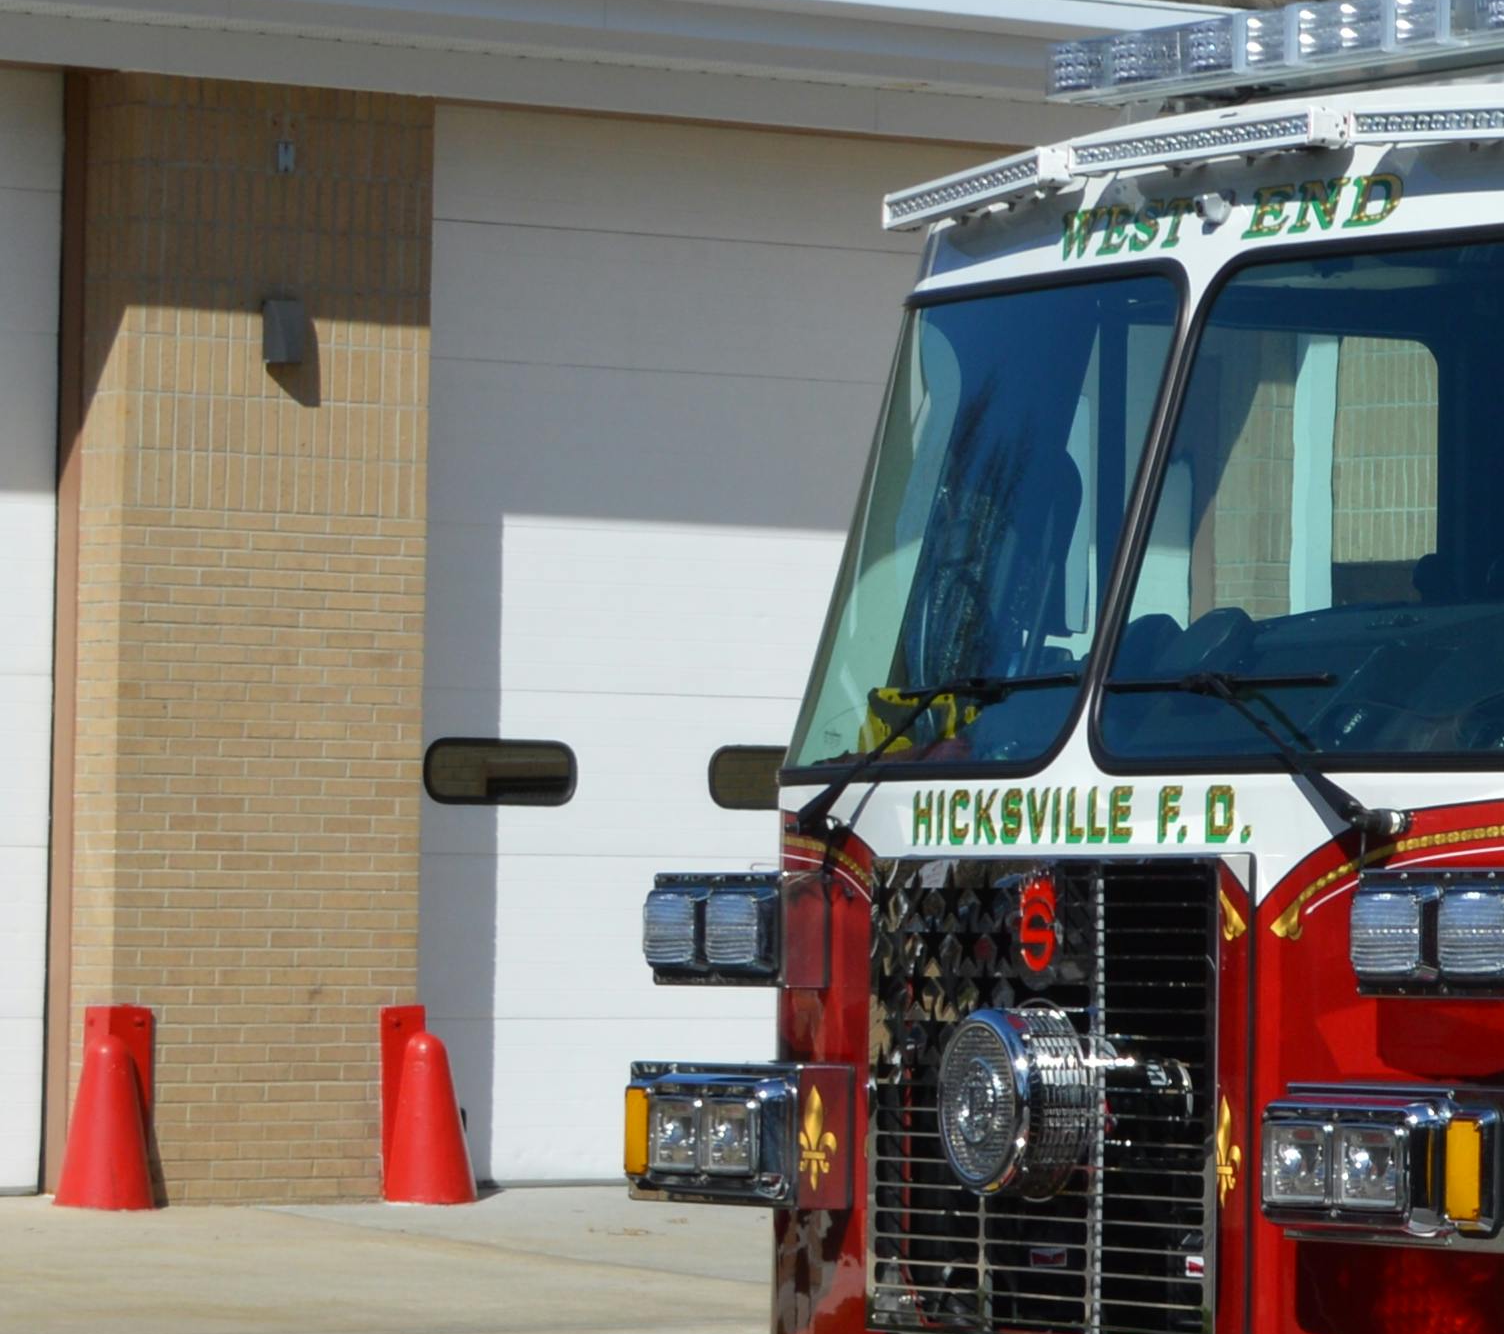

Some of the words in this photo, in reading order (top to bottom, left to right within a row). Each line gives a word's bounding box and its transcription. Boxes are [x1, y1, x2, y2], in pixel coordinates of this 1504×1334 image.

[1061, 197, 1192, 261] WEST
[1241, 172, 1403, 239] END
[912, 785, 1134, 846] HICKSVILLE
[1157, 785, 1187, 844] F.
[1204, 784, 1252, 845] D.
